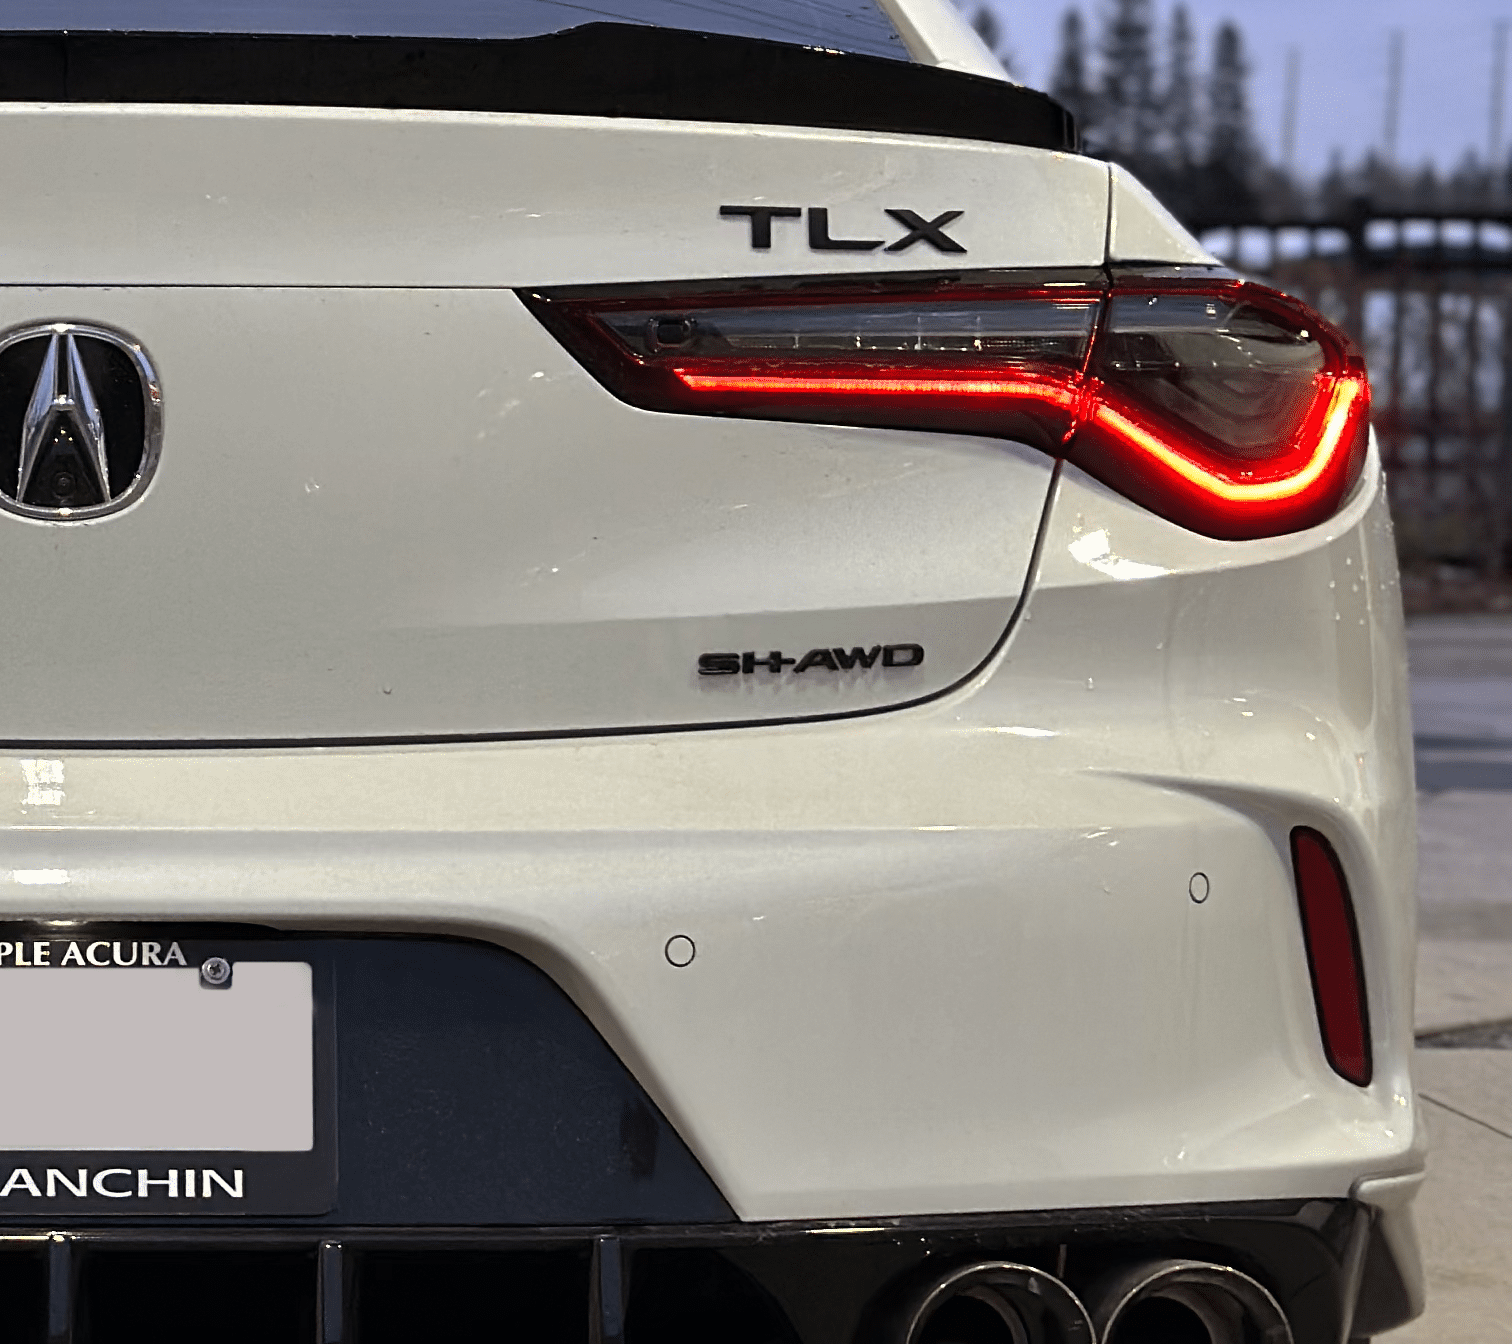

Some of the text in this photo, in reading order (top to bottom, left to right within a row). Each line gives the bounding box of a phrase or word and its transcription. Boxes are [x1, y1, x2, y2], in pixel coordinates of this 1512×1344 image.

[719, 205, 967, 254] TLX
[698, 643, 924, 675] SH-AWD
[60, 941, 188, 966] ACURA
